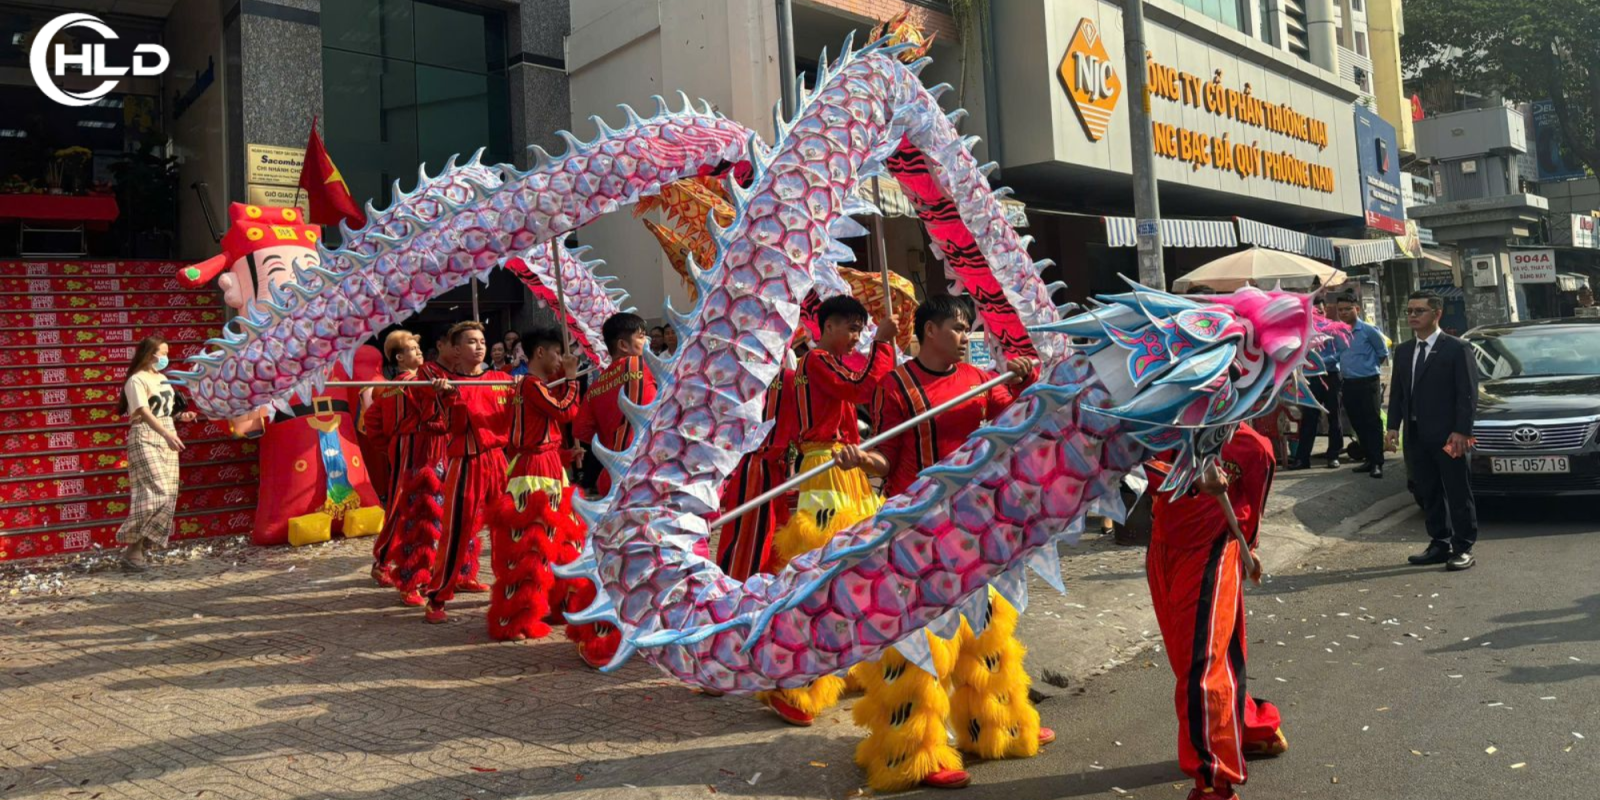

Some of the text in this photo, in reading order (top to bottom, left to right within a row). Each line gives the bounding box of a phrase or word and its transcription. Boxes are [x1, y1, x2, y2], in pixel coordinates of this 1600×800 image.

[1072, 51, 1114, 102] NJC
[1146, 51, 1179, 102] ÔNG
[1179, 71, 1201, 109] TY
[1203, 69, 1226, 116] CỔ
[1261, 101, 1307, 143] THƯƠNG
[1306, 117, 1328, 153] MẠI
[261, 155, 304, 166] Sacomban
[1151, 121, 1178, 160] NG
[1176, 127, 1211, 172] BẠC
[1210, 132, 1233, 172] ĐÁ
[1233, 140, 1260, 180] QUÝ
[1261, 150, 1310, 189] PHƯƠNG
[1308, 163, 1335, 194] NAM
[1515, 254, 1549, 264] 904A
[1493, 458, 1567, 472] 51F-057.19
